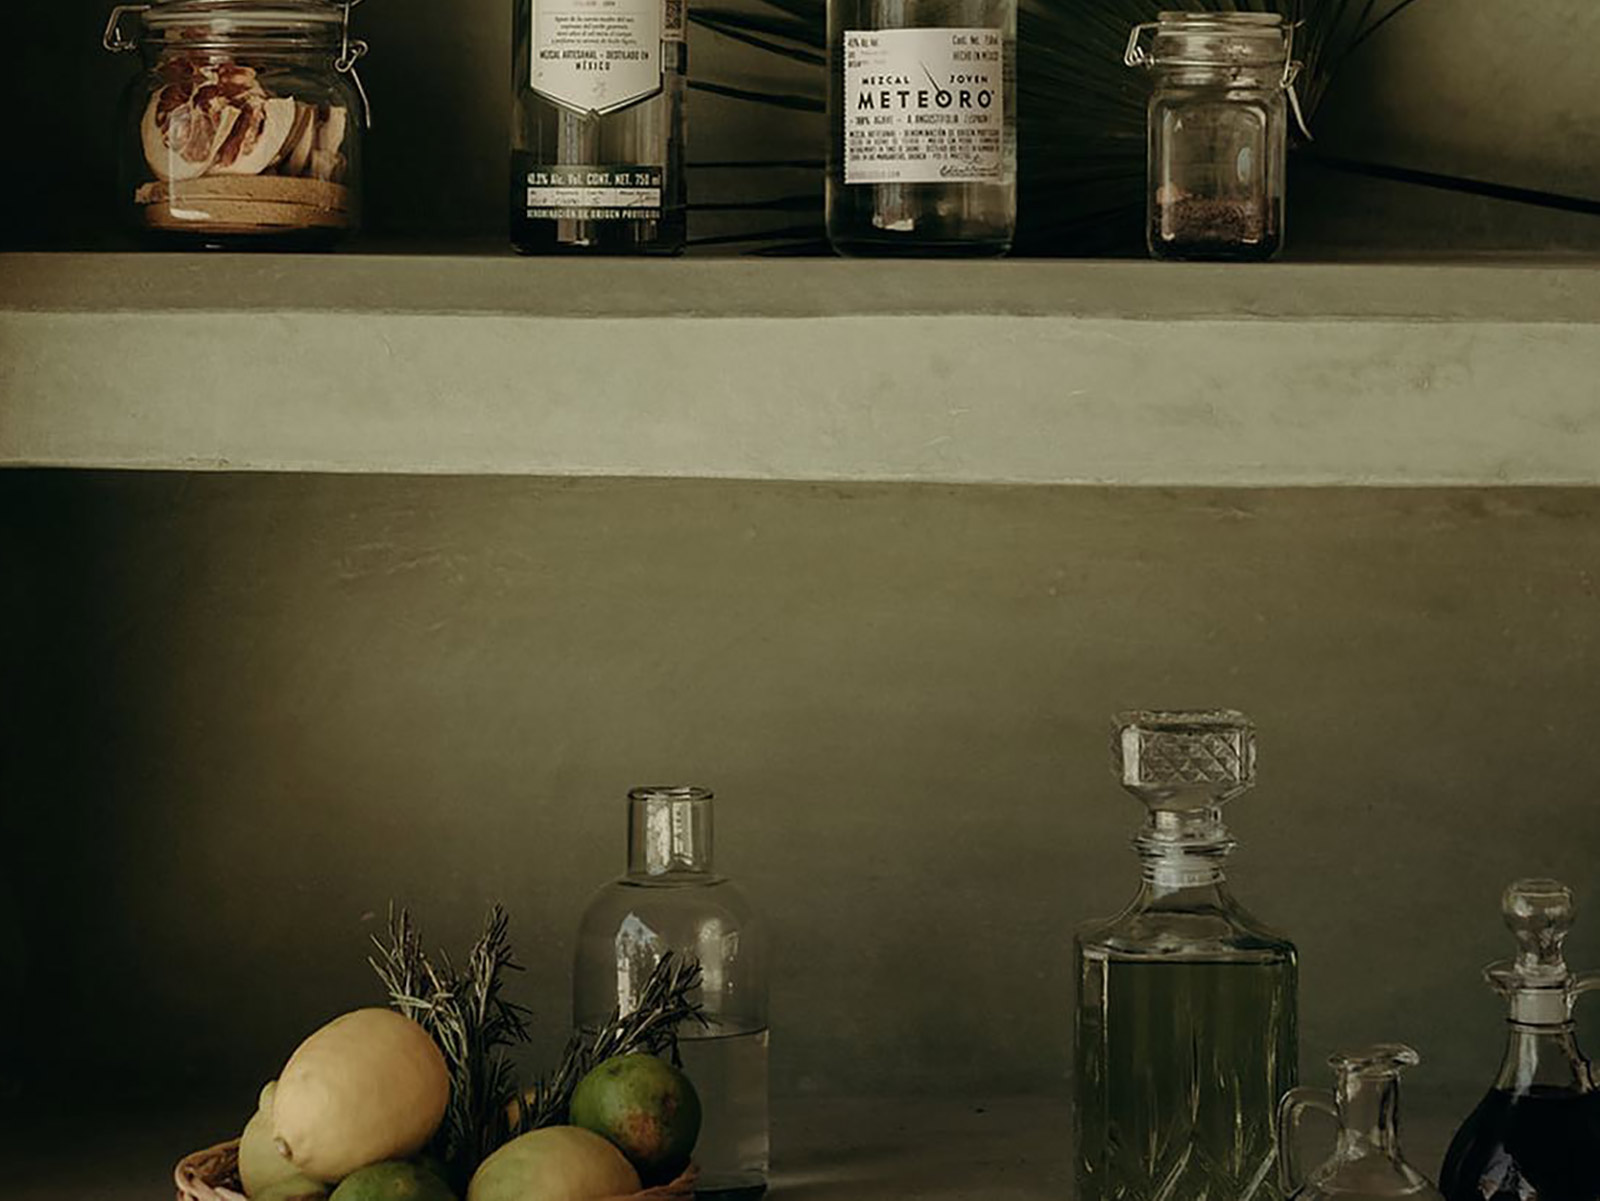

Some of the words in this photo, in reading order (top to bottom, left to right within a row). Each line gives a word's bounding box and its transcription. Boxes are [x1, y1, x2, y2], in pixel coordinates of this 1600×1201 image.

[862, 76, 910, 85] MEZCAL
[950, 74, 988, 84] JOVEN
[858, 89, 992, 110] METEORO
